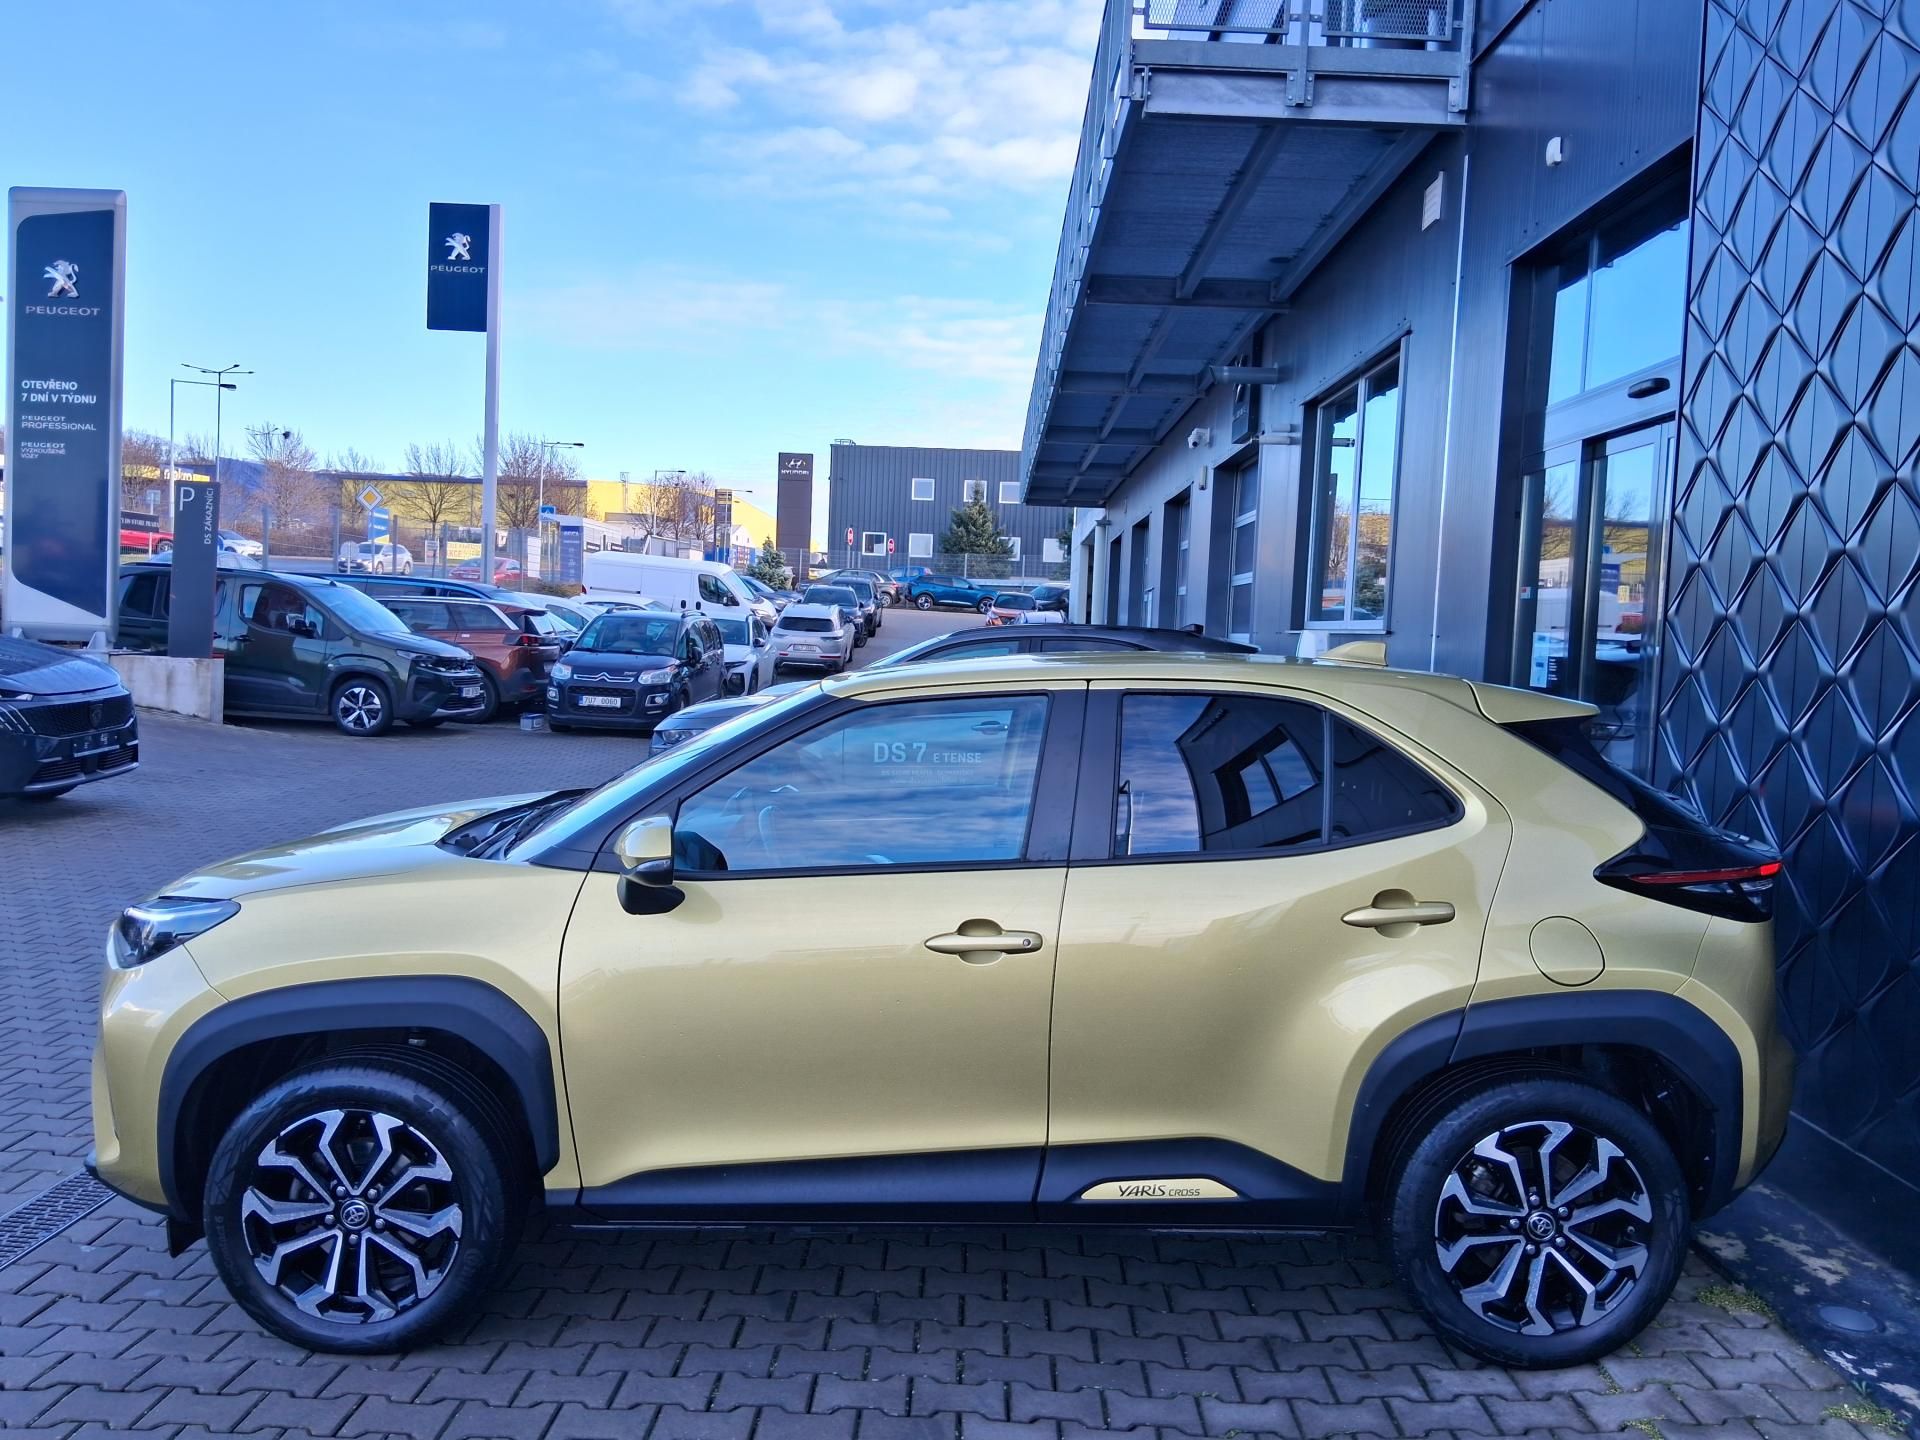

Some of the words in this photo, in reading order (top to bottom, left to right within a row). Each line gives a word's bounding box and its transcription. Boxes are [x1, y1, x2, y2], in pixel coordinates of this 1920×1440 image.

[430, 265, 486, 274] PEUGEOT
[25, 305, 101, 316] PEUGEOT
[21, 379, 78, 391] OTEVŘENO
[21, 393, 28, 402] 7
[30, 391, 49, 403] DNÍ
[51, 394, 59, 403] V
[61, 392, 97, 404] TÝDNU
[21, 421, 97, 431] PROFESSIONAL
[21, 441, 65, 449] PEUGEOT
[179, 486, 196, 512] P
[203, 533, 212, 545] DS
[873, 742, 907, 763] DS
[912, 742, 928, 763] 7
[933, 753, 942, 763] E
[943, 752, 983, 764] TENSE
[1118, 1184, 1166, 1197] YARIS
[1168, 1188, 1201, 1197] CROSS
